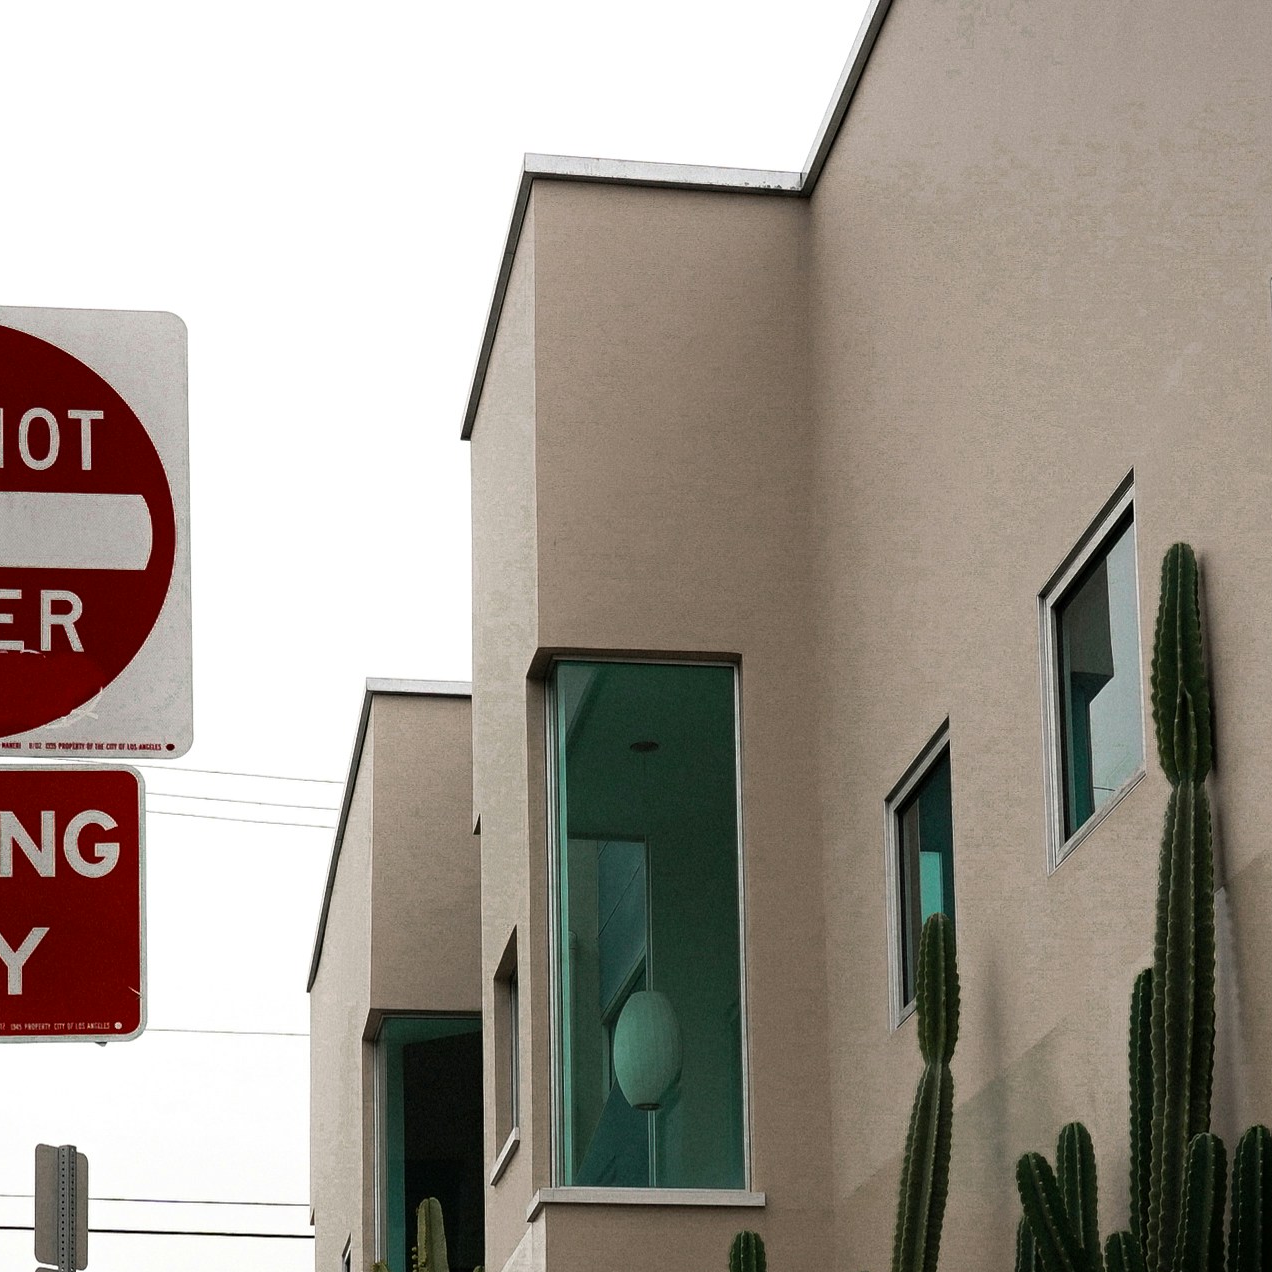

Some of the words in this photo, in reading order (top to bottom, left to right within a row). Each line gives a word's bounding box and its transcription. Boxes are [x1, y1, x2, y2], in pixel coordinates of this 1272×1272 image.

[57, 742, 85, 751] PROPERTY
[106, 742, 118, 751] CITY
[127, 742, 138, 751] LOS
[138, 743, 162, 751] ANGELES
[25, 1022, 51, 1031] PROPERTY
[54, 1022, 66, 1031] CITY
[75, 1022, 86, 1030] LOS
[87, 1022, 110, 1030] ANGELES
